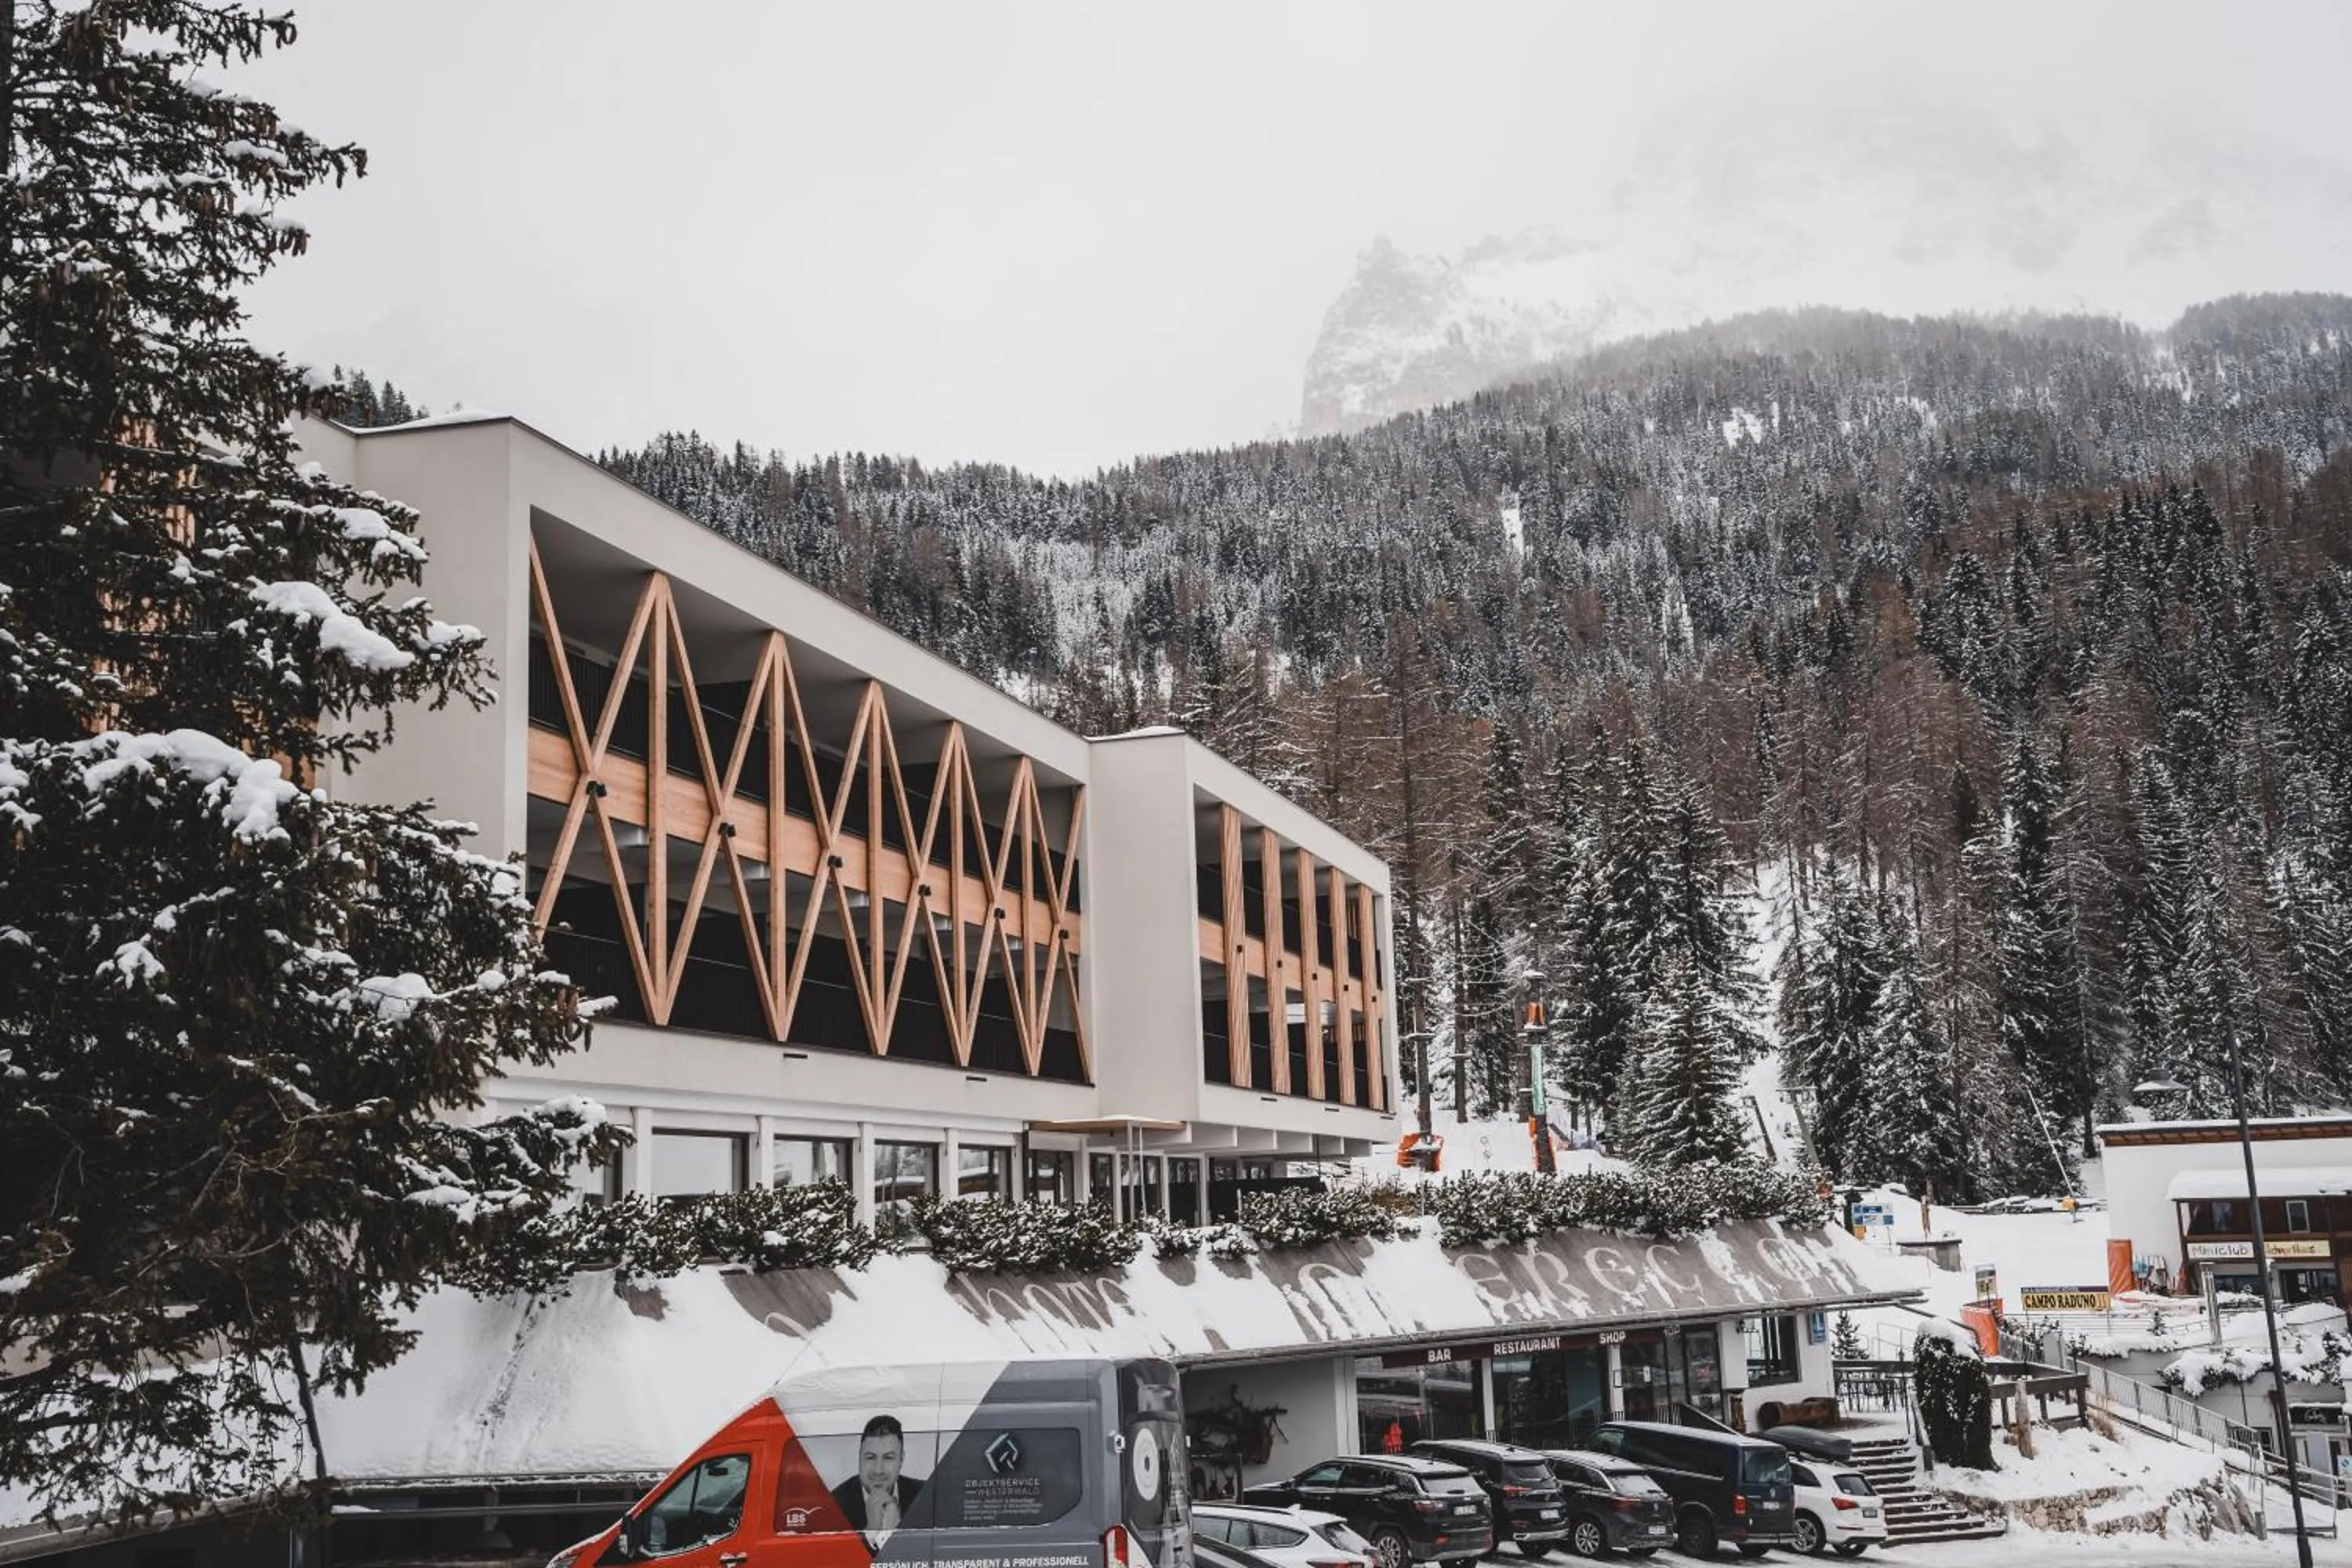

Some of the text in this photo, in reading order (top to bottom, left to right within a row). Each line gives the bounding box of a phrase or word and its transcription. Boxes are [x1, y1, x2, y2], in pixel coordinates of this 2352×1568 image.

[2025, 1294, 2055, 1308] CAMPO
[2057, 1294, 2096, 1308] RADUNO
[1599, 1331, 1626, 1345] SHOP
[1494, 1338, 1561, 1356] RESTAURANT
[1428, 1348, 1451, 1363] BAR
[786, 1513, 807, 1523] LBS
[1004, 1557, 1011, 1567] &
[1012, 1555, 1089, 1567] PROFESSIONELL
